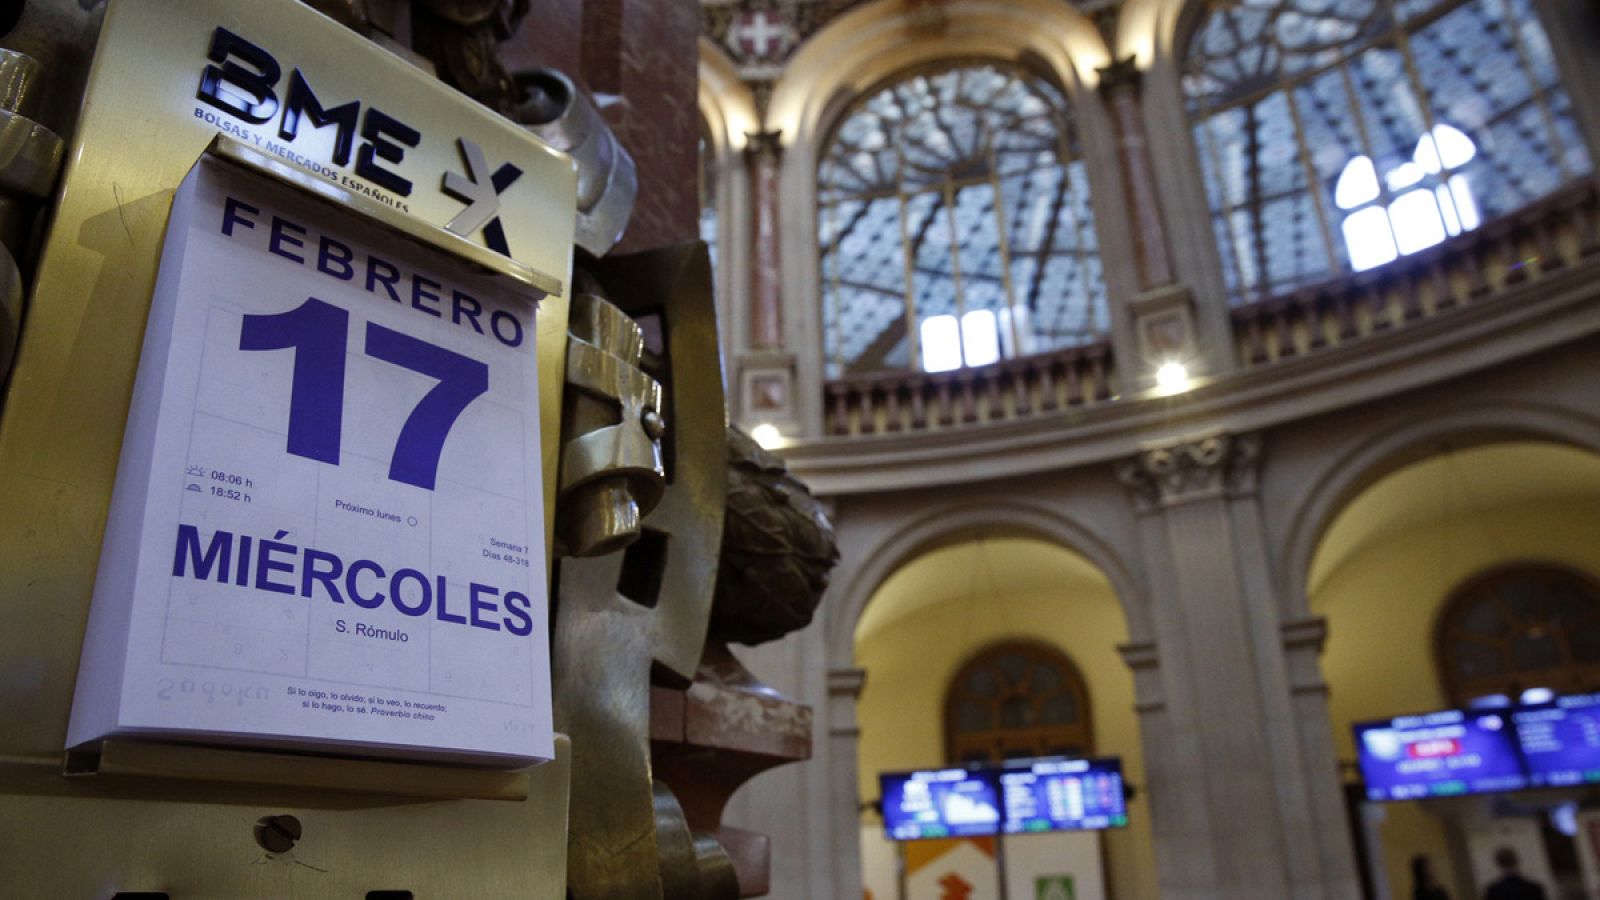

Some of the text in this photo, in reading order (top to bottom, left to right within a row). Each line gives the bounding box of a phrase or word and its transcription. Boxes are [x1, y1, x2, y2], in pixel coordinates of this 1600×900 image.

[197, 26, 421, 198] BME
[194, 107, 410, 213] BOLSAS Y MERCADOS ESPAÑOLES
[221, 197, 524, 349] FEBRERO
[239, 297, 489, 491] 17
[211, 470, 253, 488] 08:06 h
[210, 486, 252, 503] 18:52 h
[335, 499, 401, 523] Próximo lunes
[490, 537, 529, 554] Semana 7
[172, 523, 533, 637] MIÉRCOLES
[335, 619, 409, 642] S. Rómulo
[287, 686, 296, 696] Si
[298, 688, 306, 697] lo
[308, 689, 329, 700] oigo,
[330, 692, 339, 700] lo
[368, 696, 376, 705] si
[377, 697, 385, 705] lo
[404, 700, 412, 708] lo
[302, 700, 310, 709] si
[311, 701, 320, 709] lo
[322, 702, 345, 713] hago,
[346, 704, 354, 713] lo
[370, 706, 410, 719] Proverbio
[413, 711, 435, 721] chino
